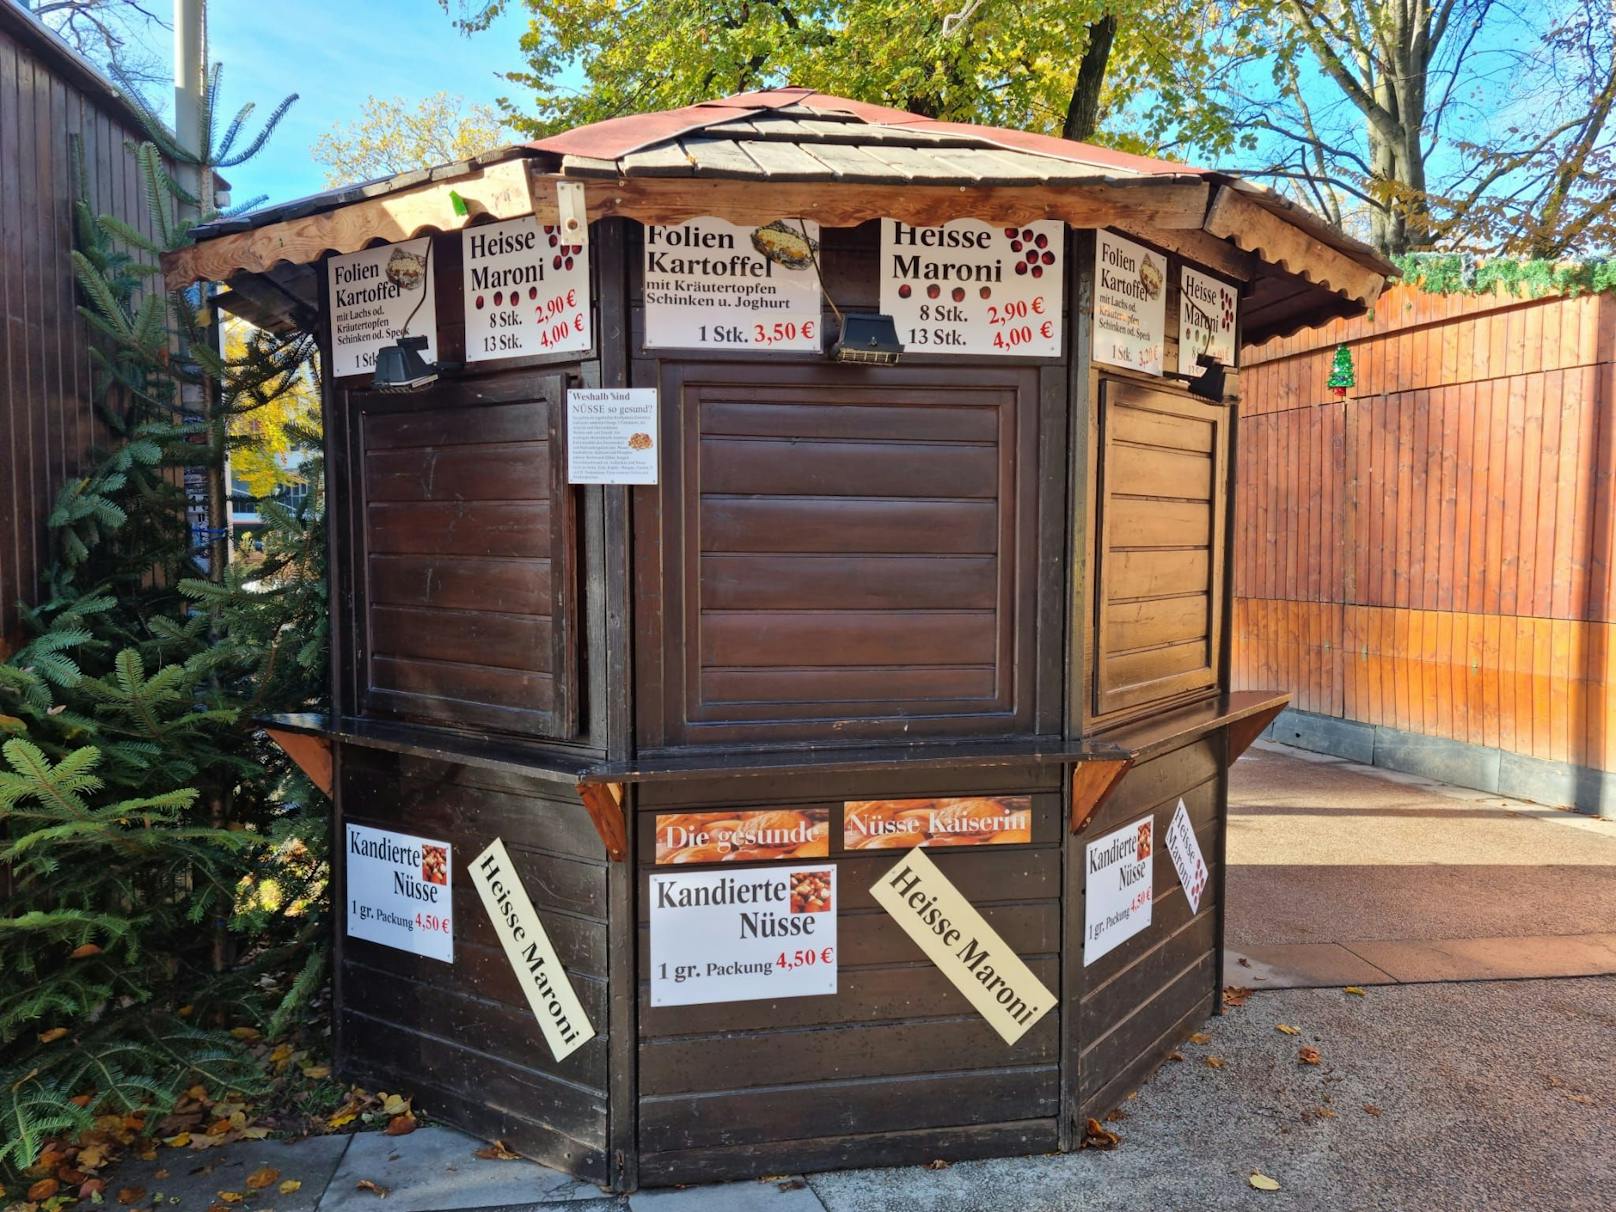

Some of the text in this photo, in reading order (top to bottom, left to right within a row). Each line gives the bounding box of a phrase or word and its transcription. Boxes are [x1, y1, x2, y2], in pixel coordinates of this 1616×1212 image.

[470, 231, 536, 259] Heisse
[648, 225, 735, 249] Folien
[894, 222, 992, 249] Heisse
[647, 251, 773, 278] Kartoffel
[892, 254, 1002, 283] Maroni
[1102, 243, 1136, 273] Folien
[335, 263, 379, 285] Folien
[471, 259, 545, 291] Maroni
[647, 279, 777, 296] mit Kräutertopfen
[1101, 269, 1148, 302] Kartoffel
[336, 279, 401, 308] Kartoffel
[647, 292, 791, 311] Schinken u. Joghurt
[1186, 275, 1217, 305] Heisse
[336, 306, 385, 322] mit Lachs od.
[490, 289, 577, 328] 8 Stk. 2,90 €
[920, 297, 1045, 326] 8 Stk. 2,90 €
[1184, 303, 1219, 334] Maroni
[337, 318, 389, 335] Kräutertopfen
[337, 332, 373, 345] Schinken
[373, 330, 385, 340] od.
[484, 312, 585, 352] 13 Stk. 4,00 €
[698, 321, 815, 344] 1 Stk. 3,50 €
[909, 320, 1055, 351] 13 Stk. 4,00 €
[355, 354, 360, 368] 1
[572, 392, 609, 401] Weshalb
[664, 820, 820, 854] Die gesunde
[848, 807, 1028, 837] Nüsse Kaiserin
[1174, 806, 1196, 864] Heisse
[350, 830, 421, 868] Kandierte
[1089, 833, 1137, 875] Kandierte
[1166, 827, 1192, 890] Maroni
[394, 870, 438, 904] Nüsse
[1119, 861, 1147, 891] Nüsse
[657, 877, 787, 909] Kandierte
[352, 899, 450, 934] 1 gr. Packung 4,50 €
[740, 911, 816, 940] Nüsse
[1088, 925, 1093, 940] 1
[1095, 921, 1105, 941] gr.
[1106, 906, 1131, 930] Packung
[480, 853, 581, 1046] Heisse Maroni
[888, 864, 1041, 1027] Heisse Maroni
[658, 947, 834, 983] 1 gr. Packung 4,50 €
